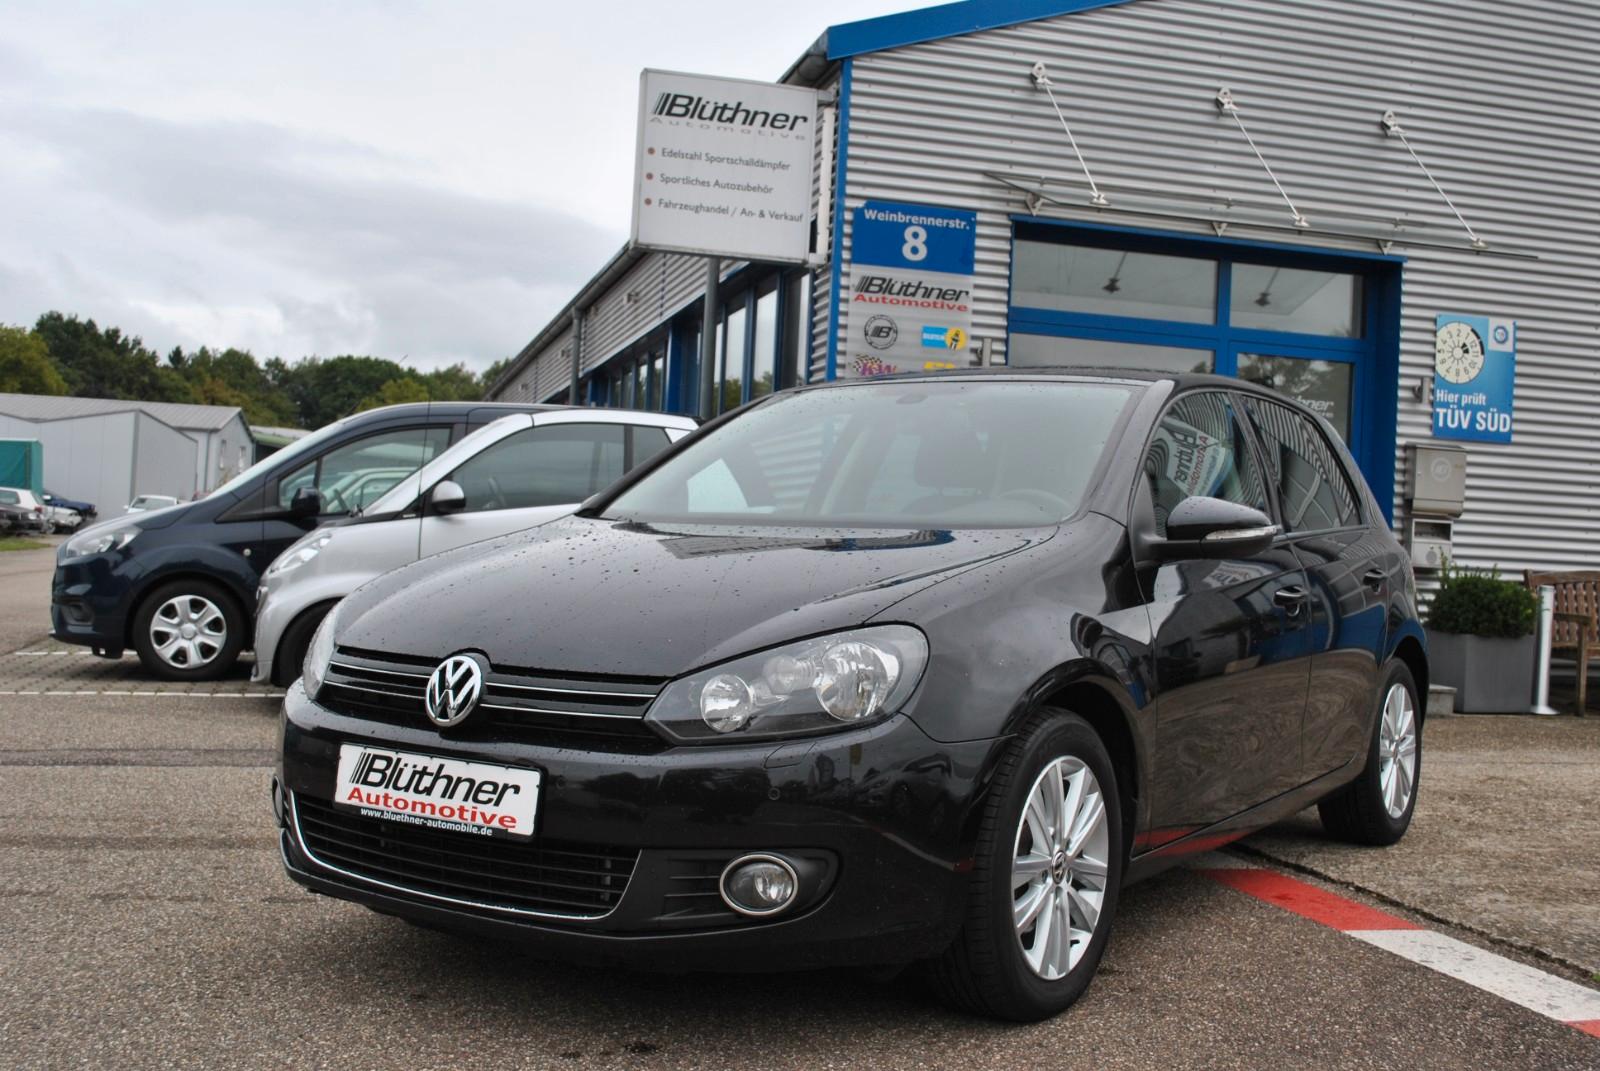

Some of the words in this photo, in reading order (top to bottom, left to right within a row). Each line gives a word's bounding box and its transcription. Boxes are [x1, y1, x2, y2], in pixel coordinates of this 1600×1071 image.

[655, 92, 808, 131] Blüthner
[650, 116, 806, 141] Automotive
[661, 147, 702, 161] Edelstahl
[704, 153, 791, 172] Sportschalldämpfer
[659, 173, 710, 188] Sportliches
[713, 180, 773, 194] Autozubehör
[658, 199, 729, 215] Fahrzeughandel
[740, 208, 756, 217] An-
[758, 209, 766, 218] &
[768, 210, 804, 223] Verkauf
[864, 208, 970, 230] Weinbrennerstr.
[902, 225, 928, 262] 8
[857, 275, 970, 302] Blüthner
[854, 293, 969, 312] Automotive
[1436, 389, 1459, 404] Hier
[1461, 392, 1487, 407] prüft
[1436, 404, 1472, 430] TÜV
[1475, 407, 1511, 433] SÜD
[351, 752, 521, 808] Blüthner
[347, 786, 517, 829] Automotive
[360, 807, 493, 836] www.bluethner-automobile.de
